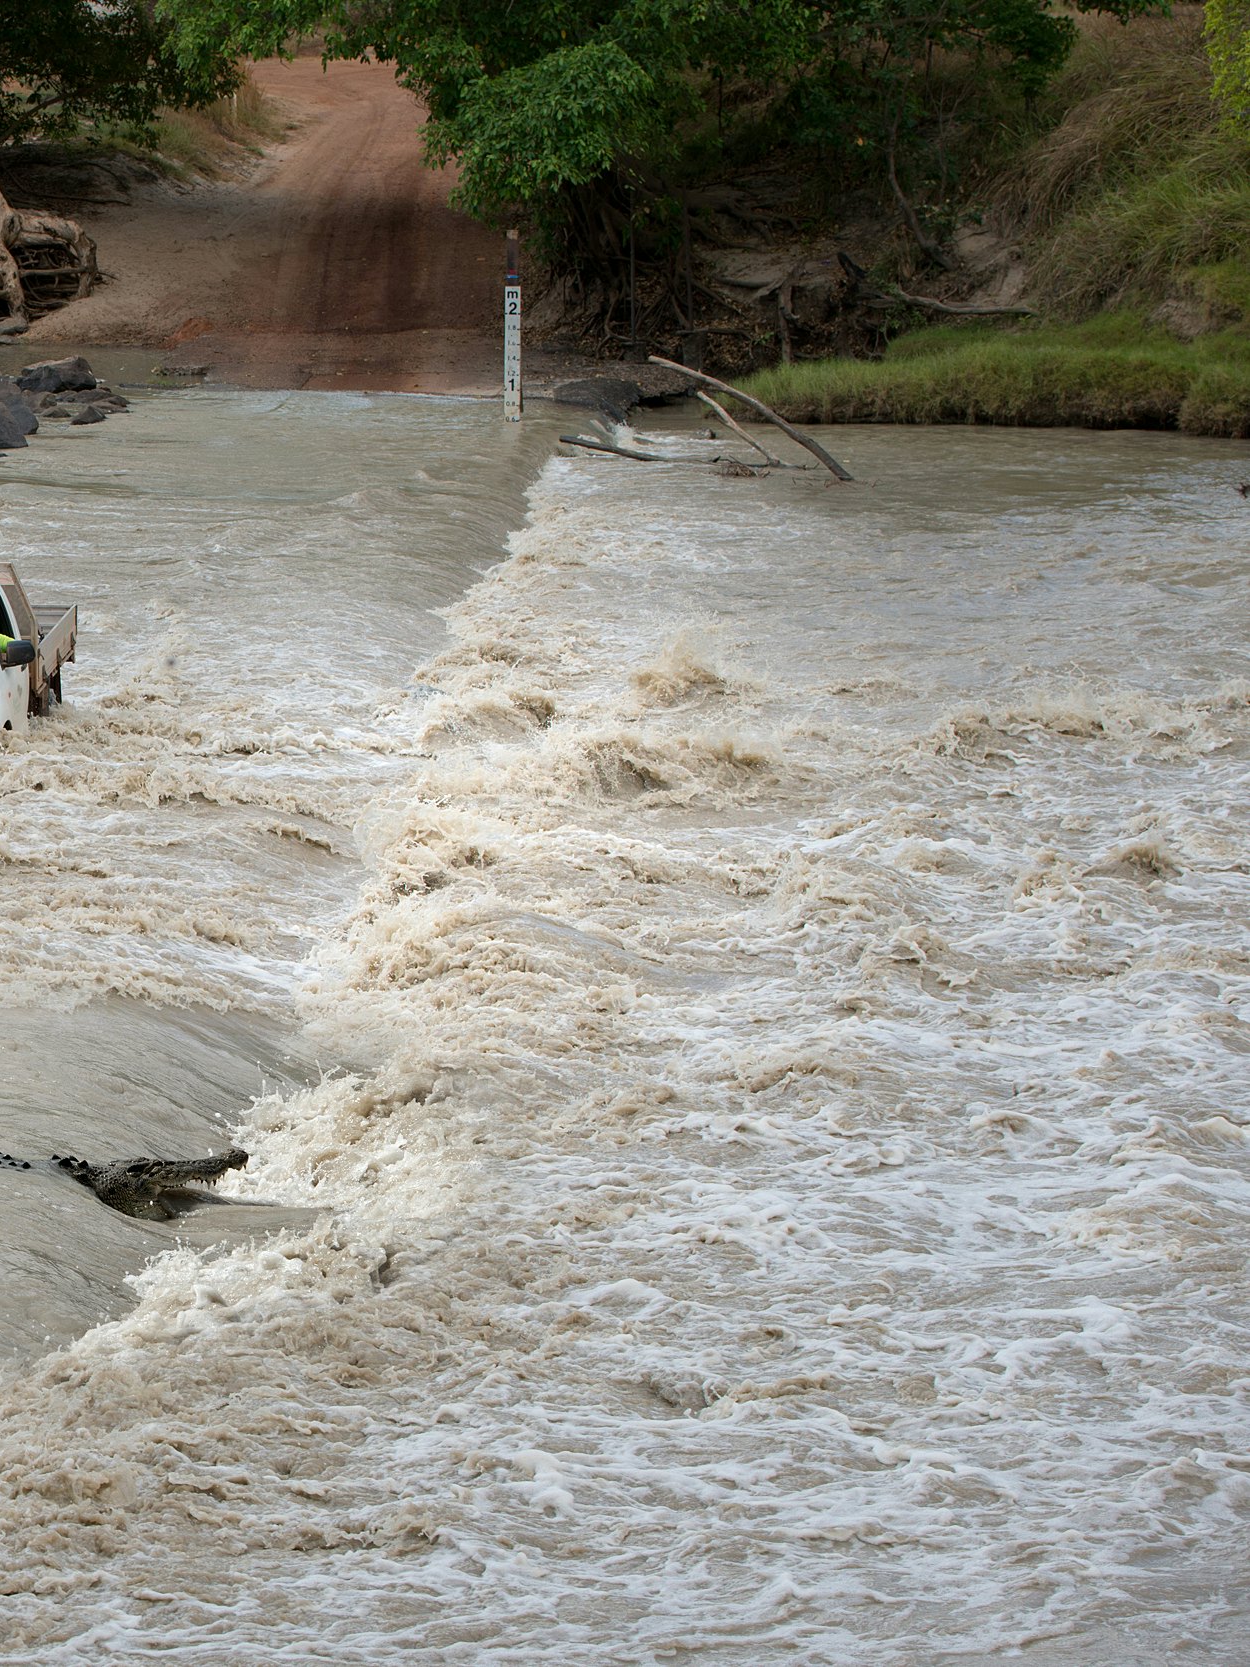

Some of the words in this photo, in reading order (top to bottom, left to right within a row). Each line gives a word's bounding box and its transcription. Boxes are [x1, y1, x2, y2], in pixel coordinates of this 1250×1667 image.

[507, 290, 519, 299] m
[508, 302, 518, 315] 2
[508, 378, 516, 392] 1
